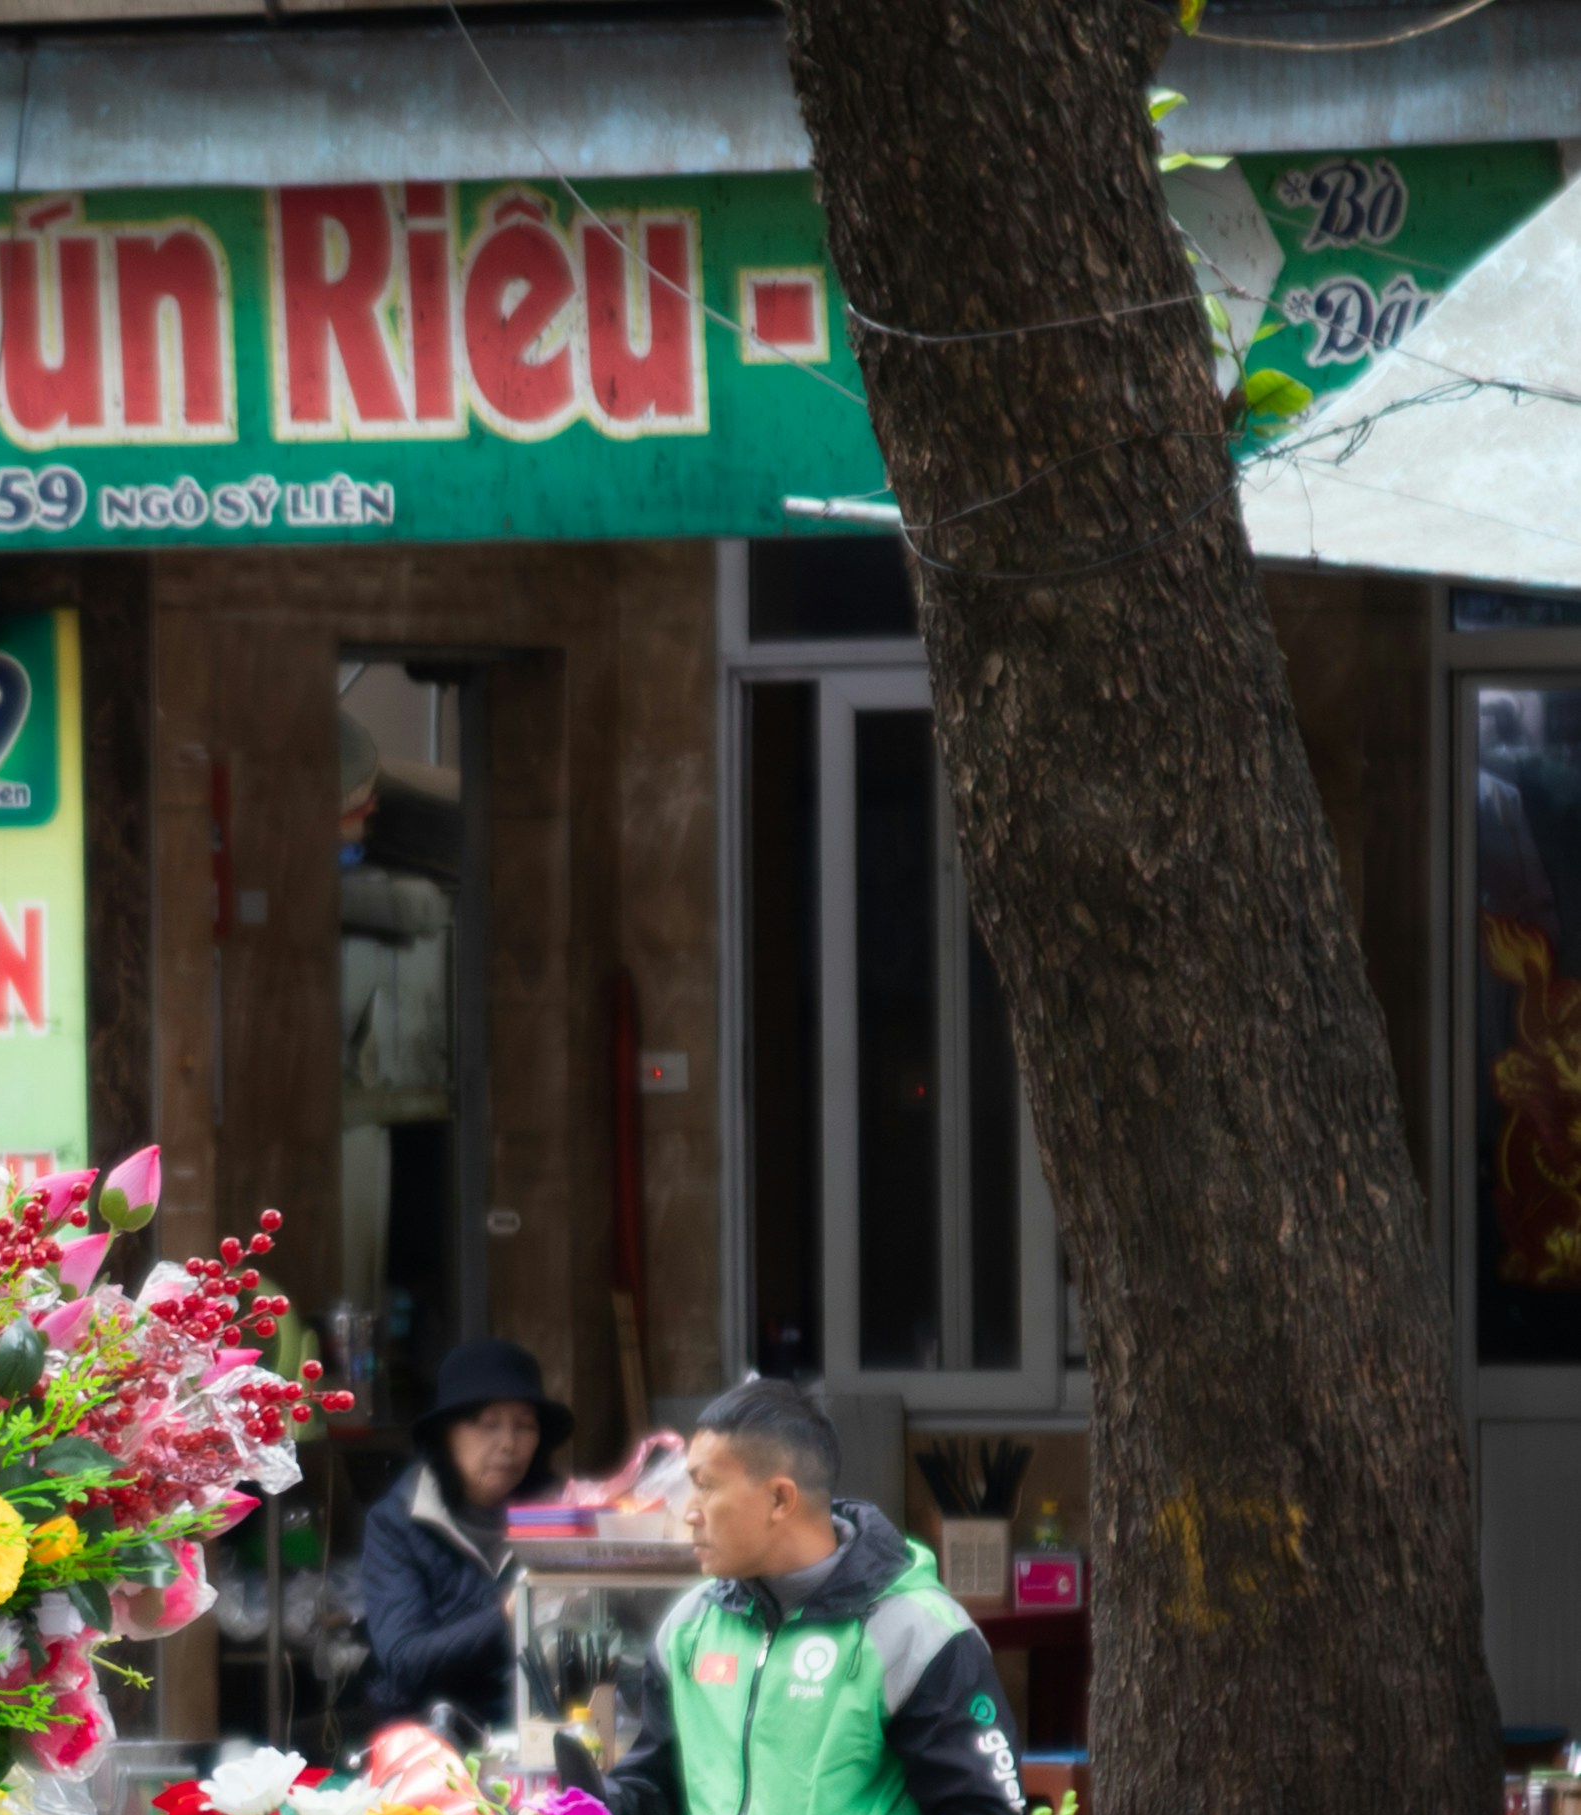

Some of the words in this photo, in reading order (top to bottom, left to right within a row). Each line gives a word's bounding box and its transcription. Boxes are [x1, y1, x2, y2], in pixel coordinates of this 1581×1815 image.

[268, 178, 708, 440] Riêu
[100, 475, 210, 529] NGÔ
[285, 472, 395, 525] LIÊN
